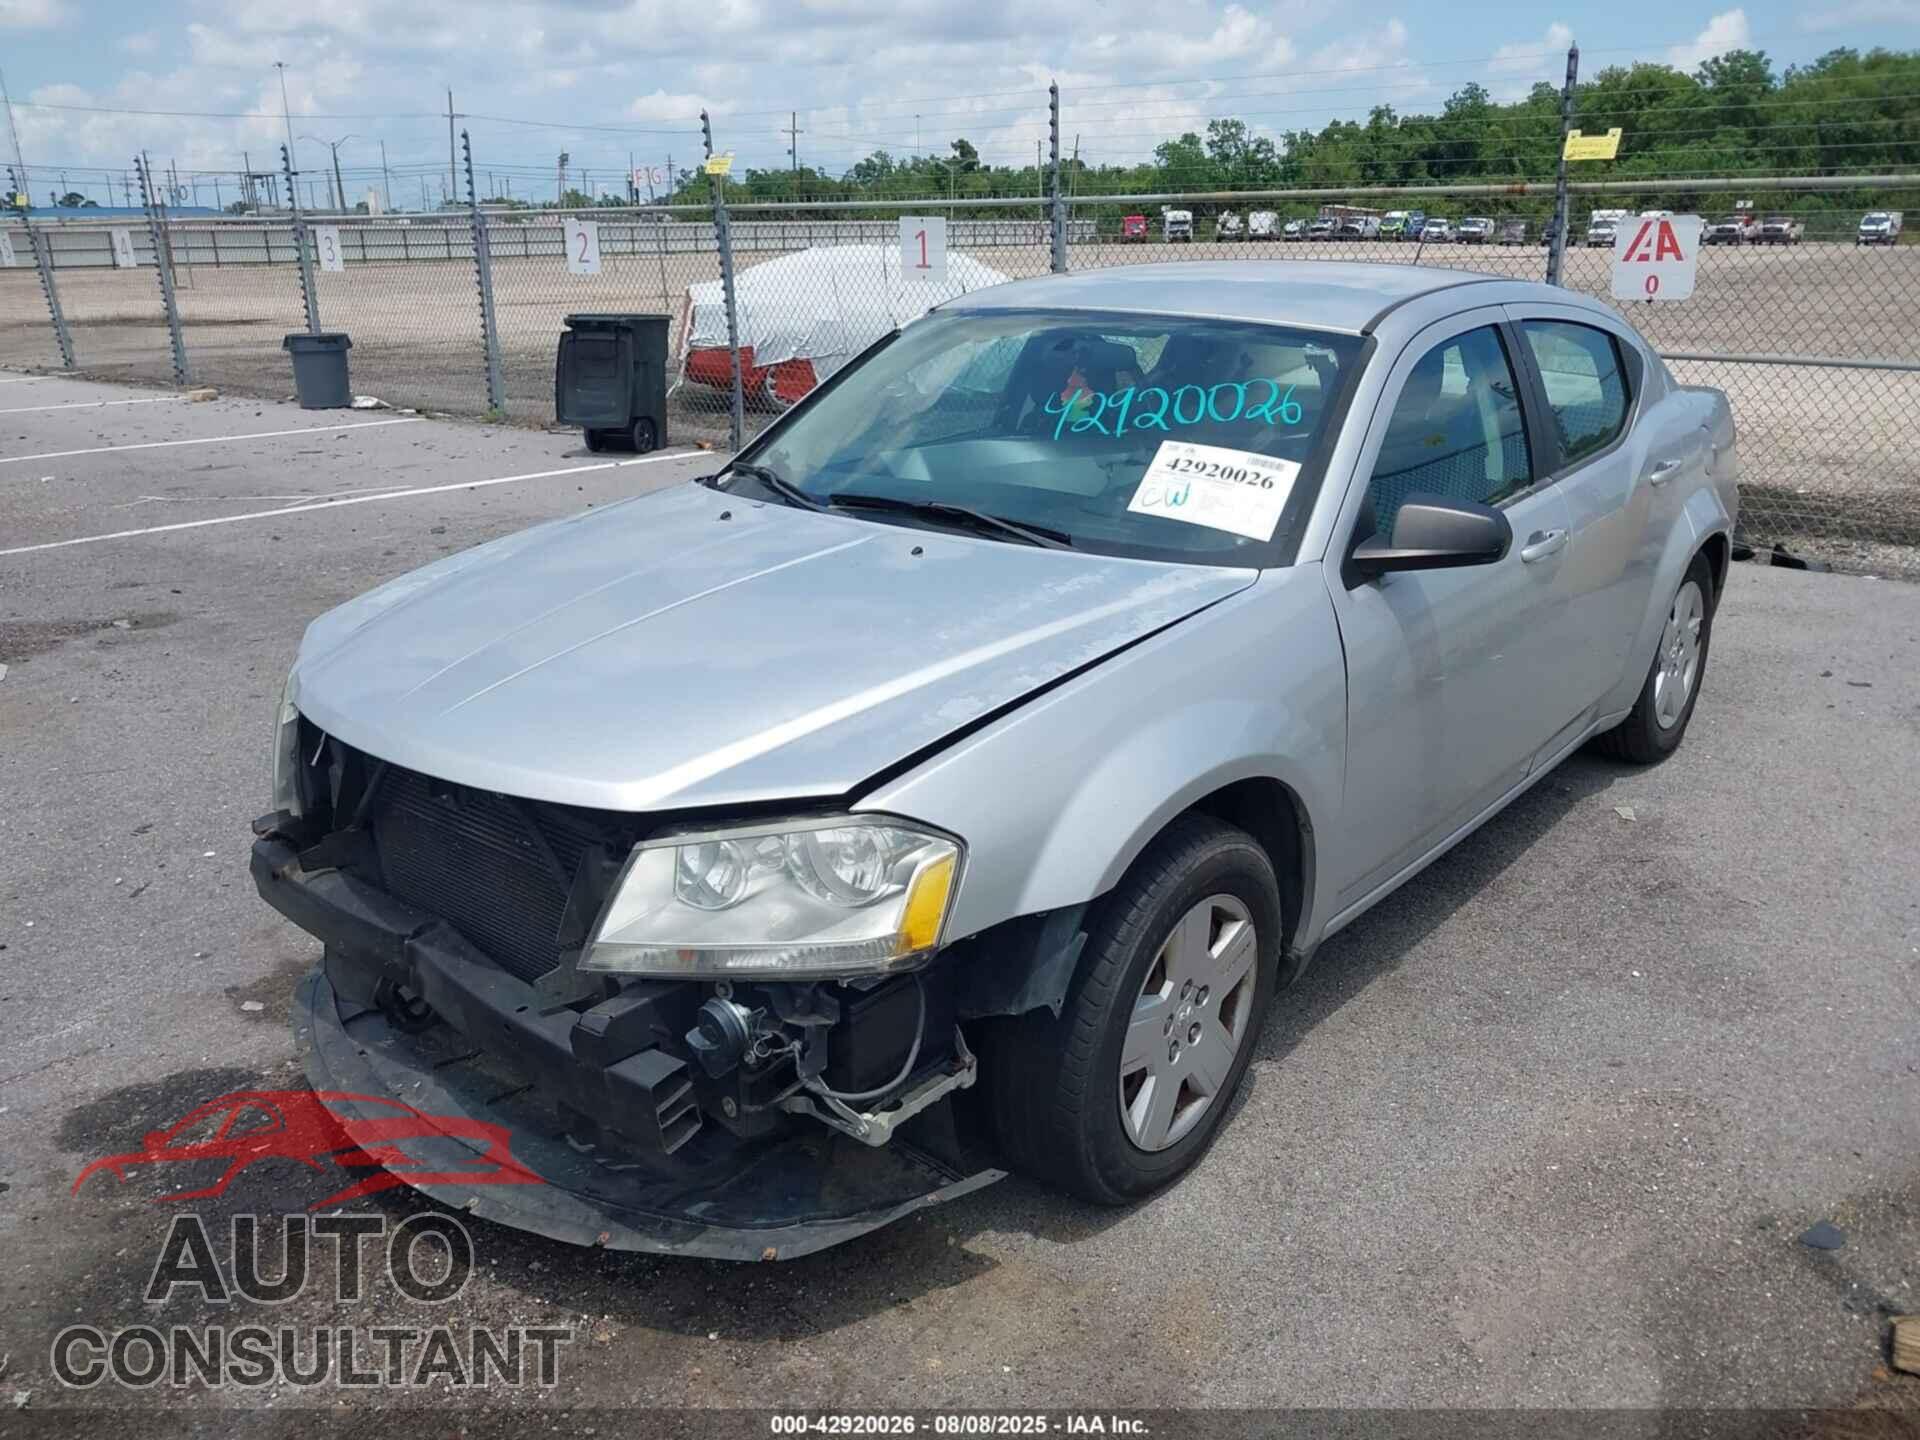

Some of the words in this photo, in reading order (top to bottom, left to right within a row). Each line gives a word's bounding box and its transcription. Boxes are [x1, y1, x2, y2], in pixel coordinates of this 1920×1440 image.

[324, 235, 336, 262] 3
[575, 231, 591, 263] 2
[914, 229, 932, 269] 1
[1043, 377, 1303, 441] 42920026
[1165, 456, 1276, 490] 42920026
